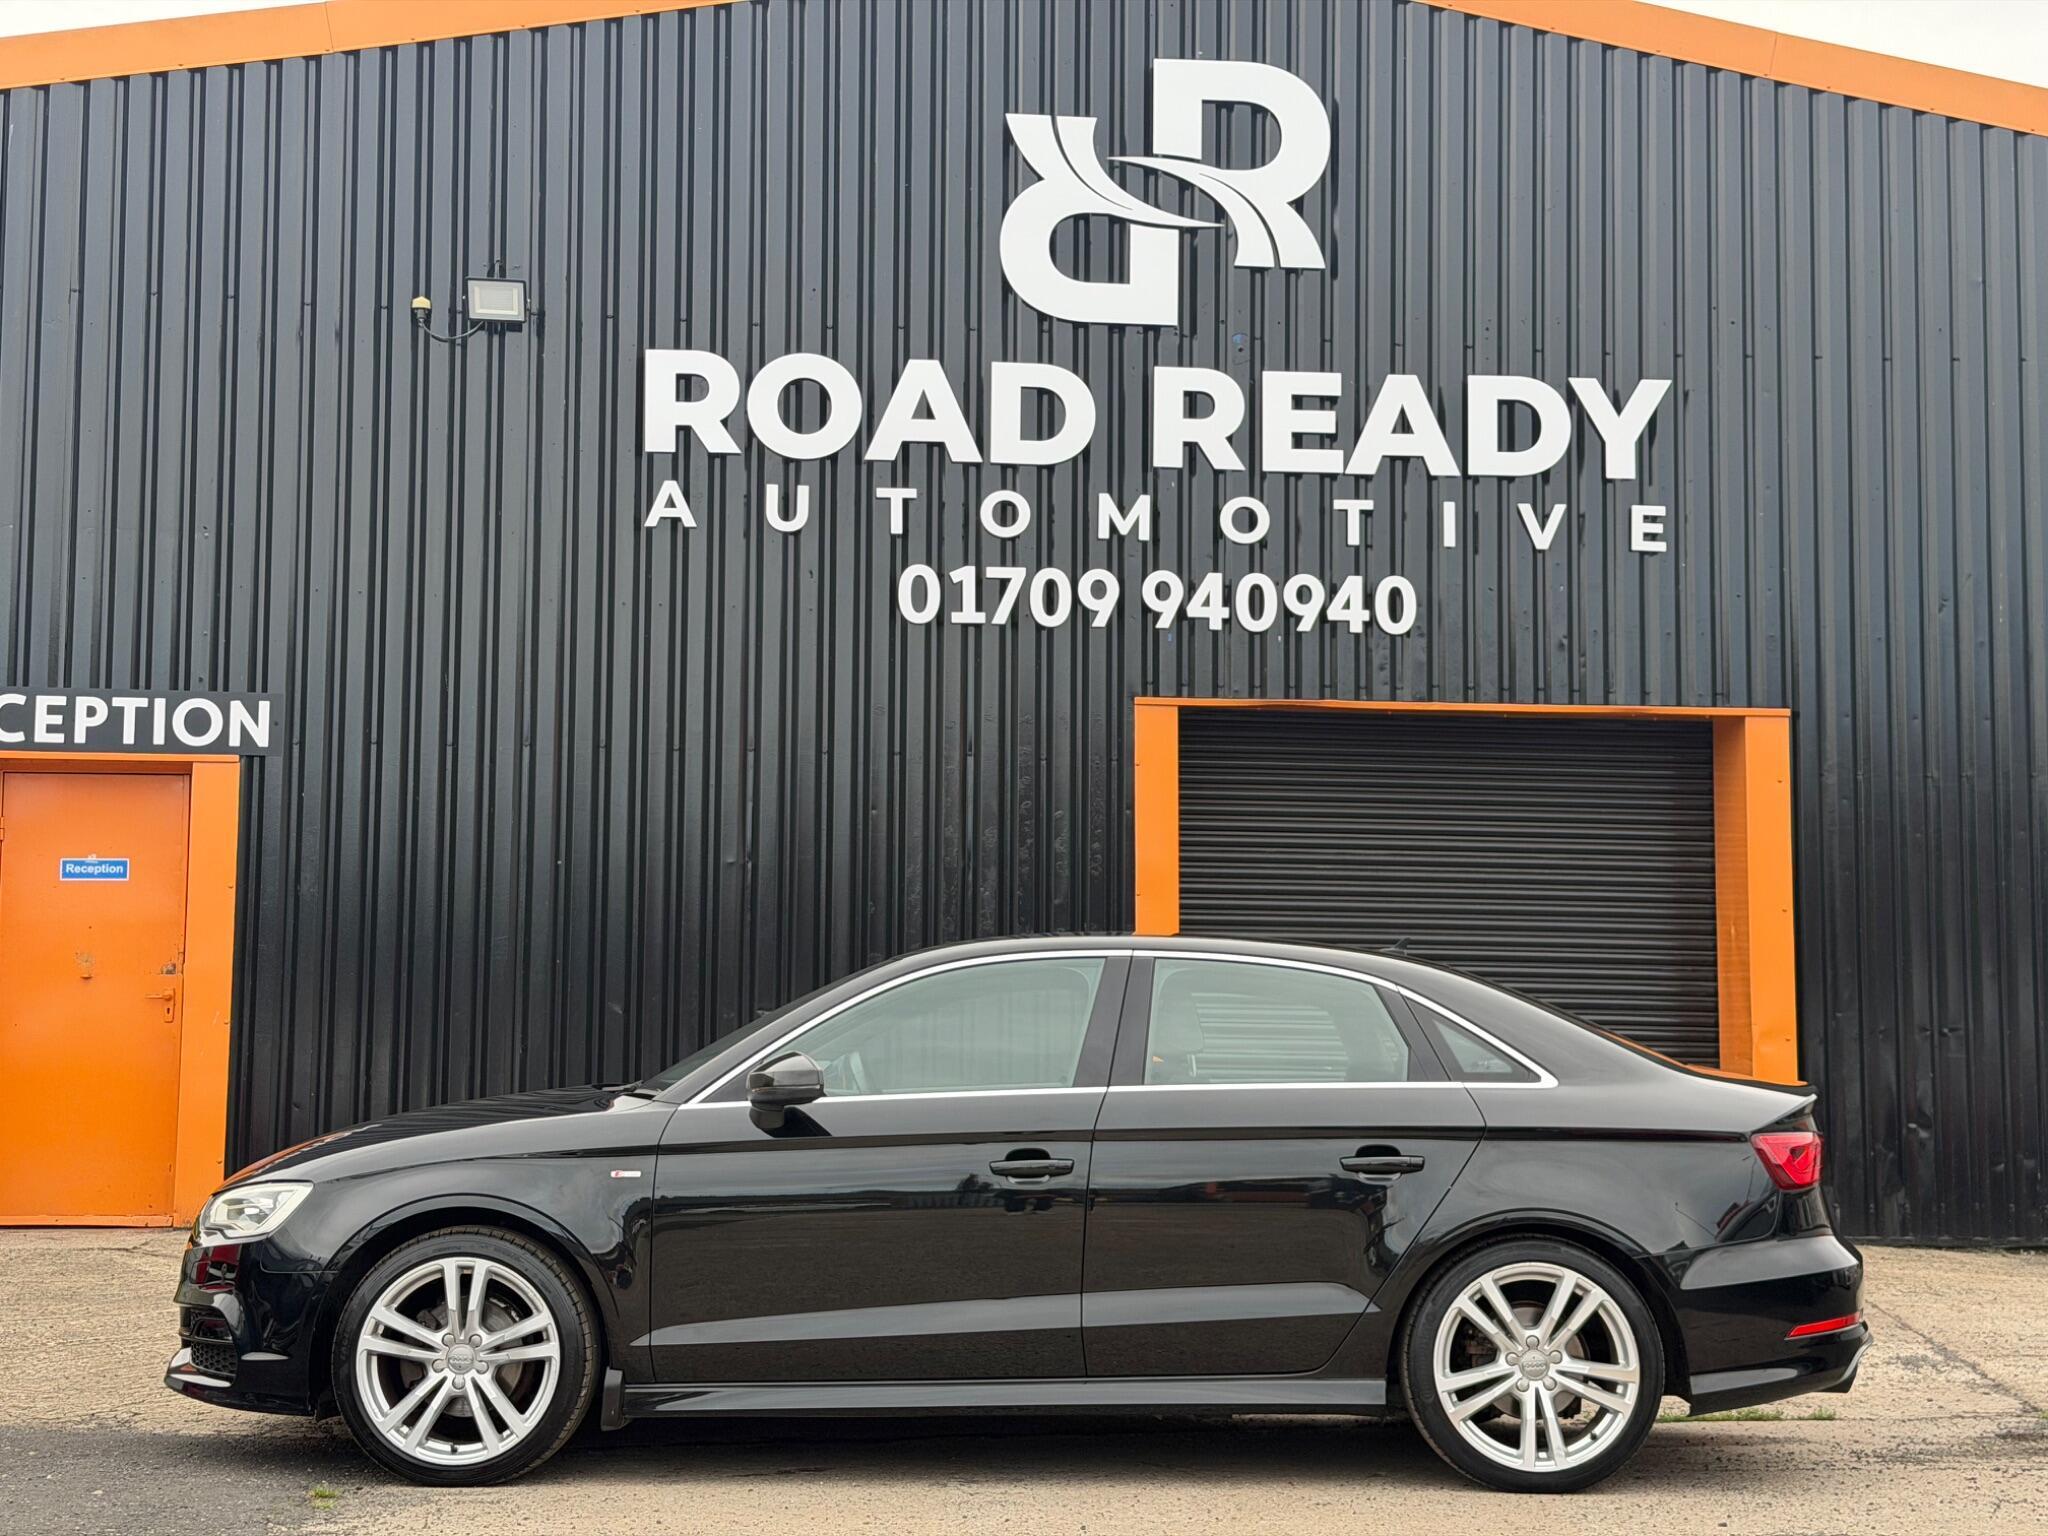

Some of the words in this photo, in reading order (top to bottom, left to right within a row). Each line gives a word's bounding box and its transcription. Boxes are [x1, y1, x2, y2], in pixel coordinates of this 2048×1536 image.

[644, 348, 1096, 465] ROAD
[1152, 365, 1673, 480] READY
[643, 479, 1667, 553] AUTOMOTIVE
[898, 563, 1120, 628] 01709
[1141, 569, 1417, 635] 940940
[65, 863, 124, 876] Reception
